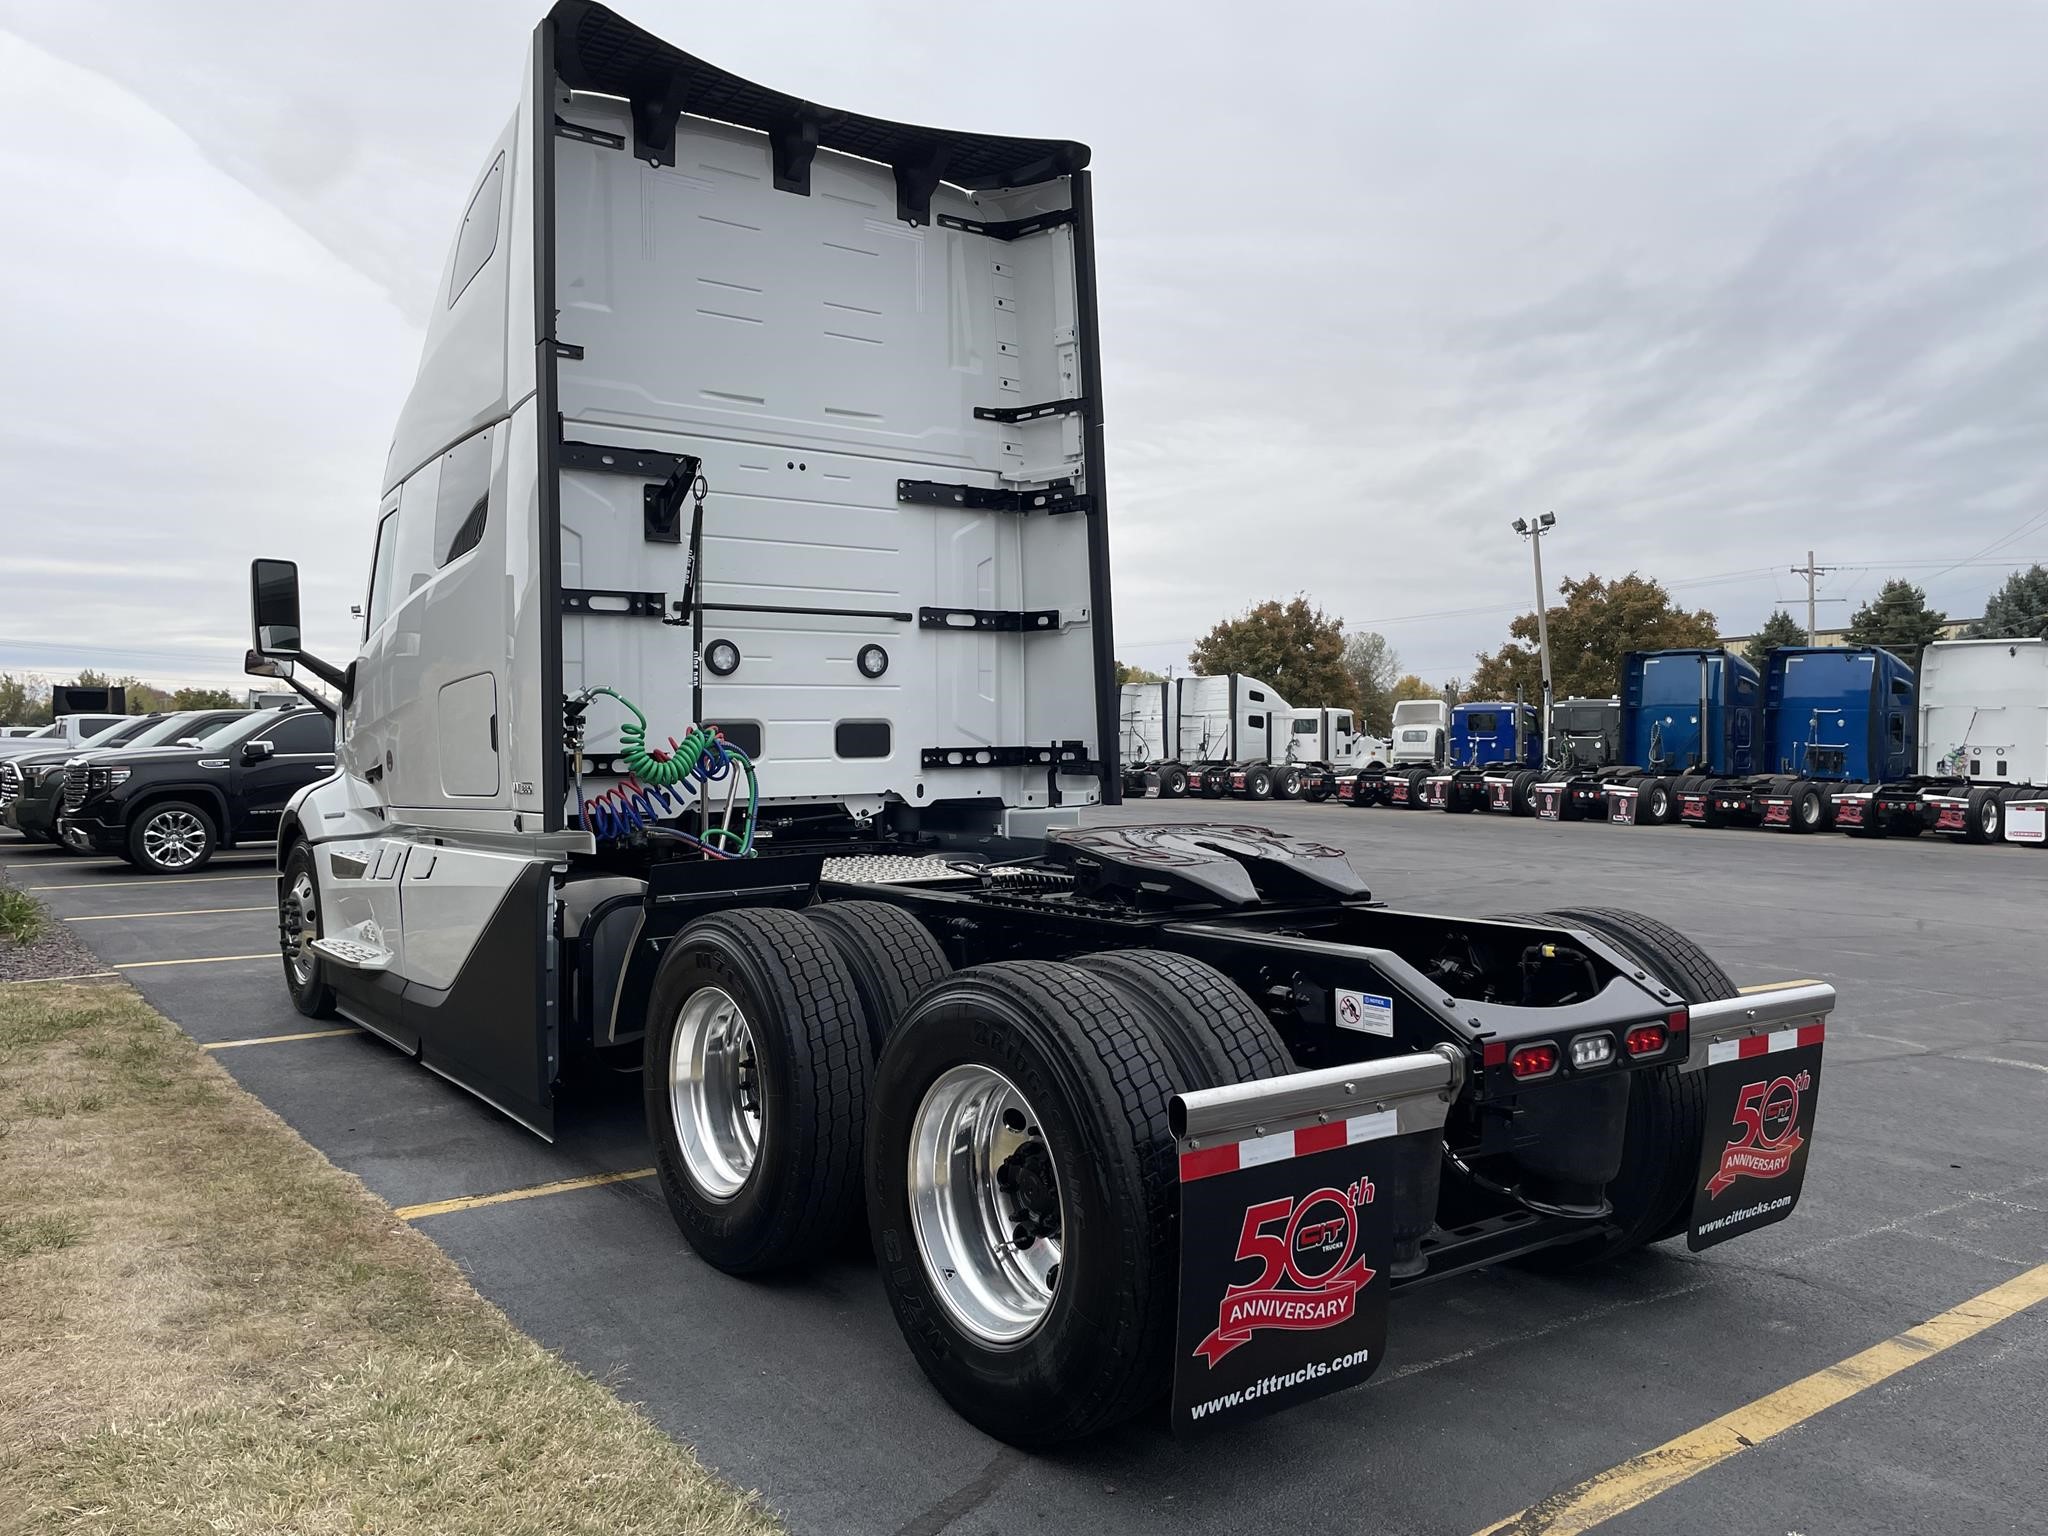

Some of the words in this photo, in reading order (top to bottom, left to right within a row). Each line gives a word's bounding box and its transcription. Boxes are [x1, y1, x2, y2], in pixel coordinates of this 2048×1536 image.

[1725, 1153, 1787, 1171] ANNIVERSARY
[1697, 1194, 1791, 1236] www.cittrucks.com
[1322, 1241, 1344, 1252] TRUCKS
[1229, 1295, 1349, 1324] ANNIVERSARY
[1190, 1347, 1369, 1420] www.cittrucks.com
